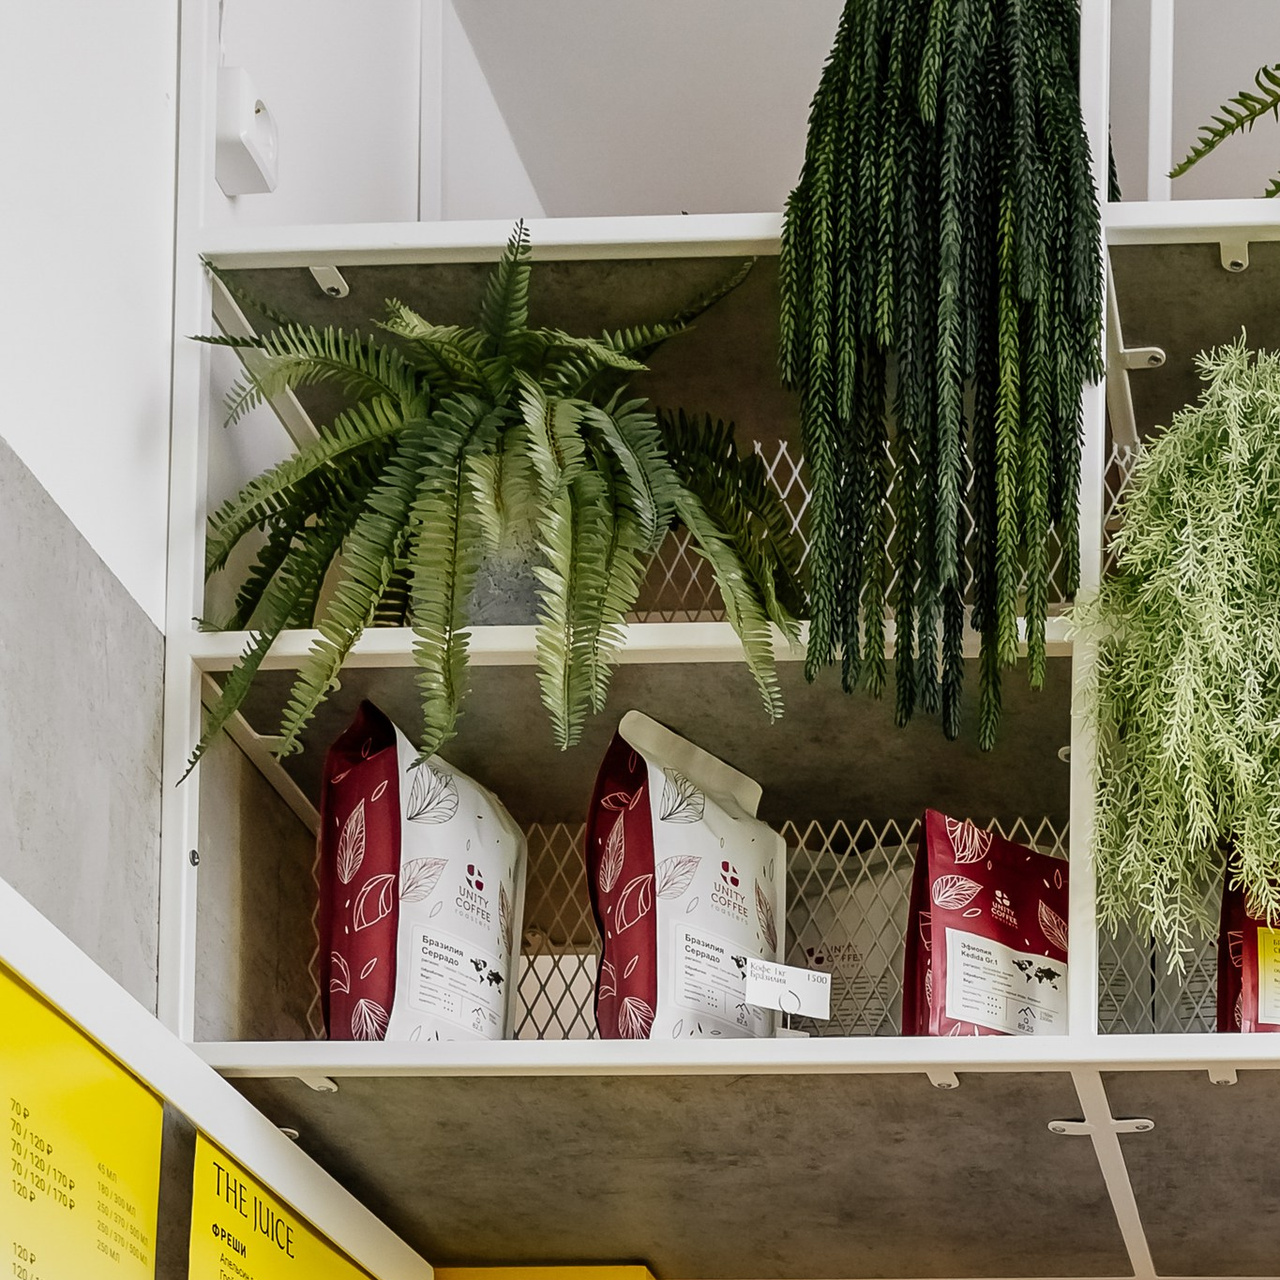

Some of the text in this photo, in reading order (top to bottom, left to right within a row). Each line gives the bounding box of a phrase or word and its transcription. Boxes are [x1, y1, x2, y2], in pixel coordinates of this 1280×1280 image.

[459, 885, 489, 909] UNITY
[713, 882, 746, 903] UNITY
[455, 897, 491, 924] COFFEE
[711, 893, 749, 918] COFFEE
[711, 904, 749, 926] roasters
[991, 907, 1018, 925] COFFEE
[992, 901, 1015, 916] UNITY
[454, 908, 491, 931] roasters
[422, 935, 464, 958] Бразилия
[685, 933, 725, 955] Бразилия
[685, 944, 721, 964] Серрадо
[961, 943, 992, 956] Эфиопия
[421, 946, 460, 967] Серрадо
[961, 950, 984, 962] Kedida
[750, 962, 828, 985] Кофе 1кг 1500
[750, 971, 787, 986] Бразилия
[10, 1098, 21, 1116] 70
[10, 1118, 21, 1136] 70
[30, 1132, 45, 1152] 120
[11, 1138, 22, 1156] 70
[30, 1152, 45, 1172] 120
[53, 1168, 68, 1188] 170
[11, 1158, 22, 1176] 70
[30, 1172, 45, 1192] 120
[53, 1187, 68, 1207] 170
[12, 1179, 28, 1199] 120
[97, 1200, 109, 1217] 250
[213, 1161, 295, 1260] THE JUICE
[97, 1219, 109, 1236] 250
[13, 1242, 28, 1261] 120
[211, 1223, 247, 1259] ФРЕШИ
